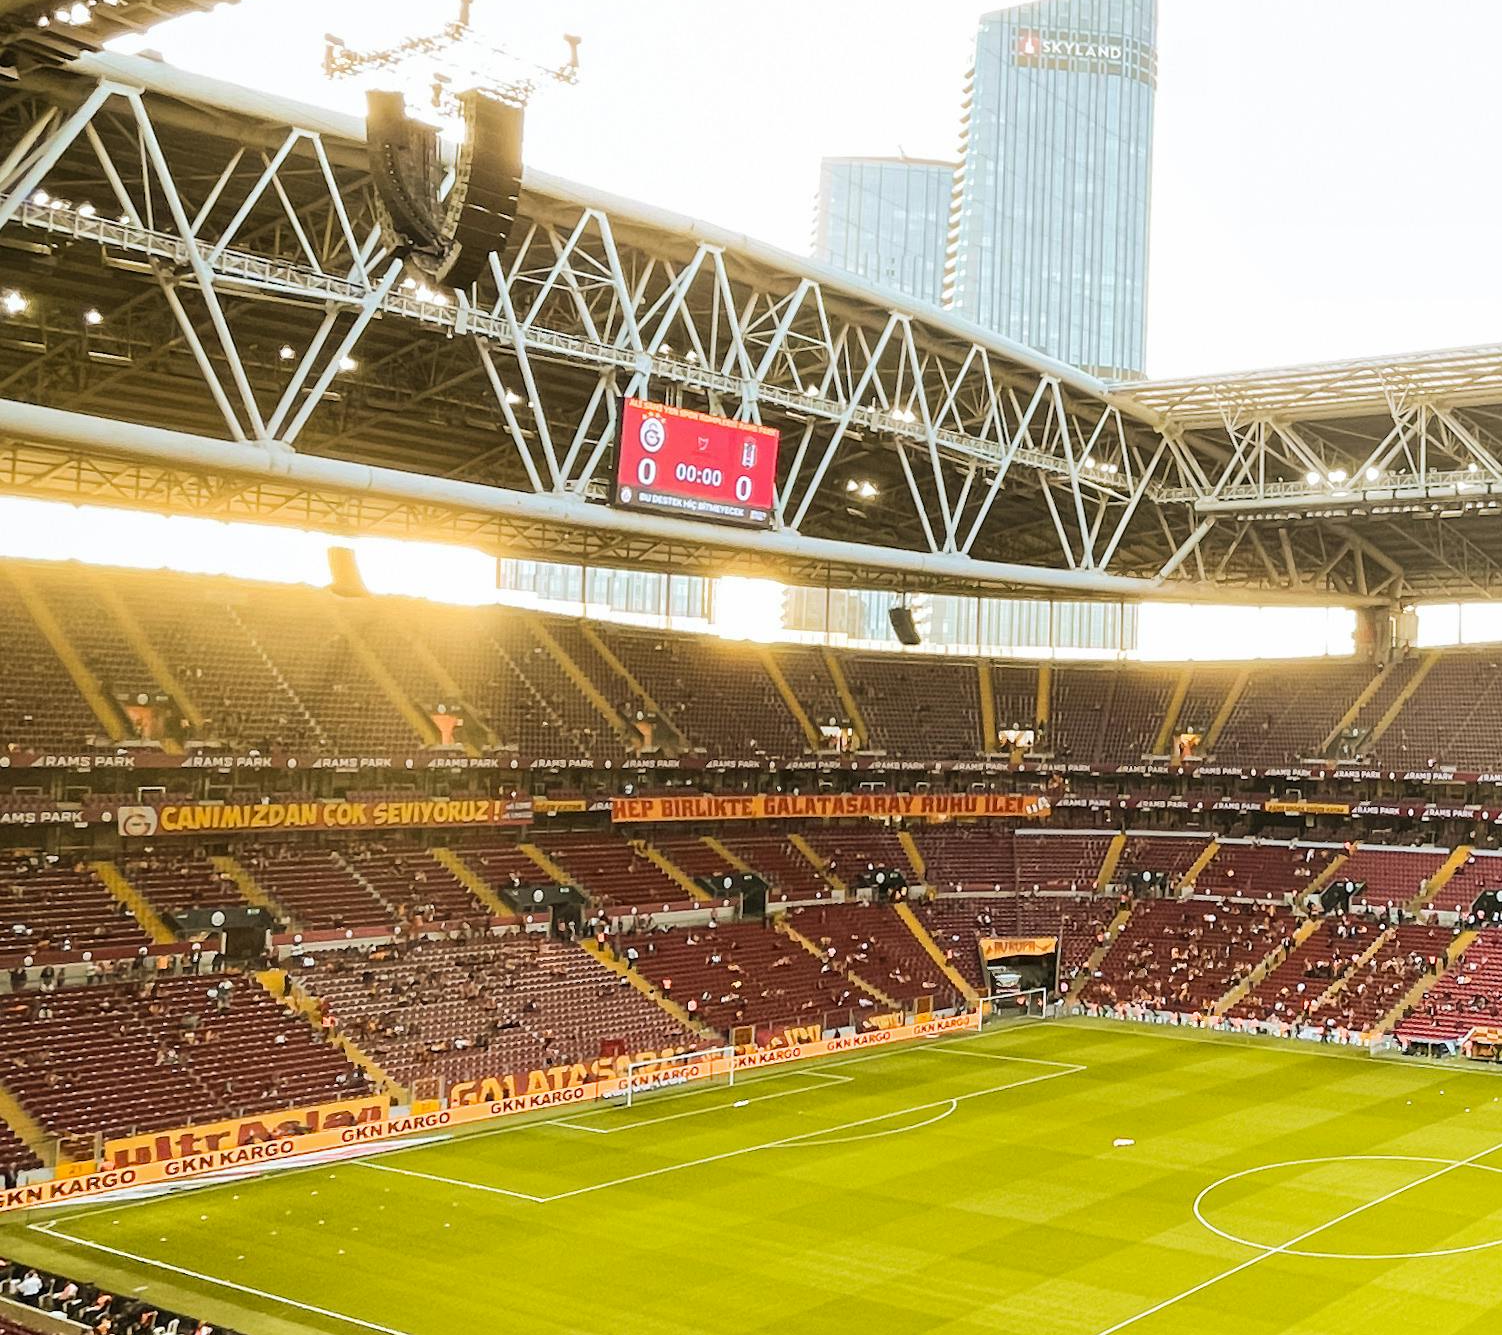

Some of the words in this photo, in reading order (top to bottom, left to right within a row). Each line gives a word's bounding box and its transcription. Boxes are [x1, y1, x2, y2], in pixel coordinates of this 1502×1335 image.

[1042, 40, 1121, 59] SKYLAND
[638, 458, 656, 485] 0
[676, 463, 722, 487] 00:00
[736, 475, 752, 501] 0
[46, 756, 90, 767] RAMS
[95, 756, 135, 767] PARK
[192, 757, 233, 767] RAMS
[237, 757, 272, 767] PARK
[321, 758, 357, 768] RAMS
[361, 758, 391, 768] PARK
[435, 758, 468, 768] RAMS
[471, 758, 498, 768] PARK
[538, 759, 566, 768] RAMS
[569, 759, 594, 768] PARK
[40, 812, 83, 823] PARK
[161, 802, 318, 831] CANIMIZDAN
[494, 800, 501, 821] !
[613, 799, 654, 819] HEP
[764, 796, 913, 816] GALATASARAY
[921, 796, 977, 815] RUHU
[1356, 806, 1379, 815] RAMS
[1380, 806, 1400, 815] PARK
[1428, 809, 1451, 818] RAMS
[1453, 809, 1473, 818] PARK
[914, 1024, 935, 1035] GKN
[937, 1017, 971, 1032] KARGO
[827, 1040, 850, 1052] GKN
[852, 1032, 890, 1048] KARGO
[732, 1056, 756, 1068] GKN
[760, 1048, 801, 1065] KARGO
[450, 1047, 684, 1106] GALATASARA
[619, 1074, 649, 1091] GKN
[652, 1066, 699, 1084] KARGO
[491, 1099, 525, 1114] GKN
[531, 1087, 584, 1109] KARGO
[342, 1123, 382, 1143] GKN
[388, 1113, 451, 1134] KARGO
[165, 1154, 214, 1176] GKN
[220, 1141, 294, 1166] KARGO
[50, 1170, 136, 1200] KARGO
